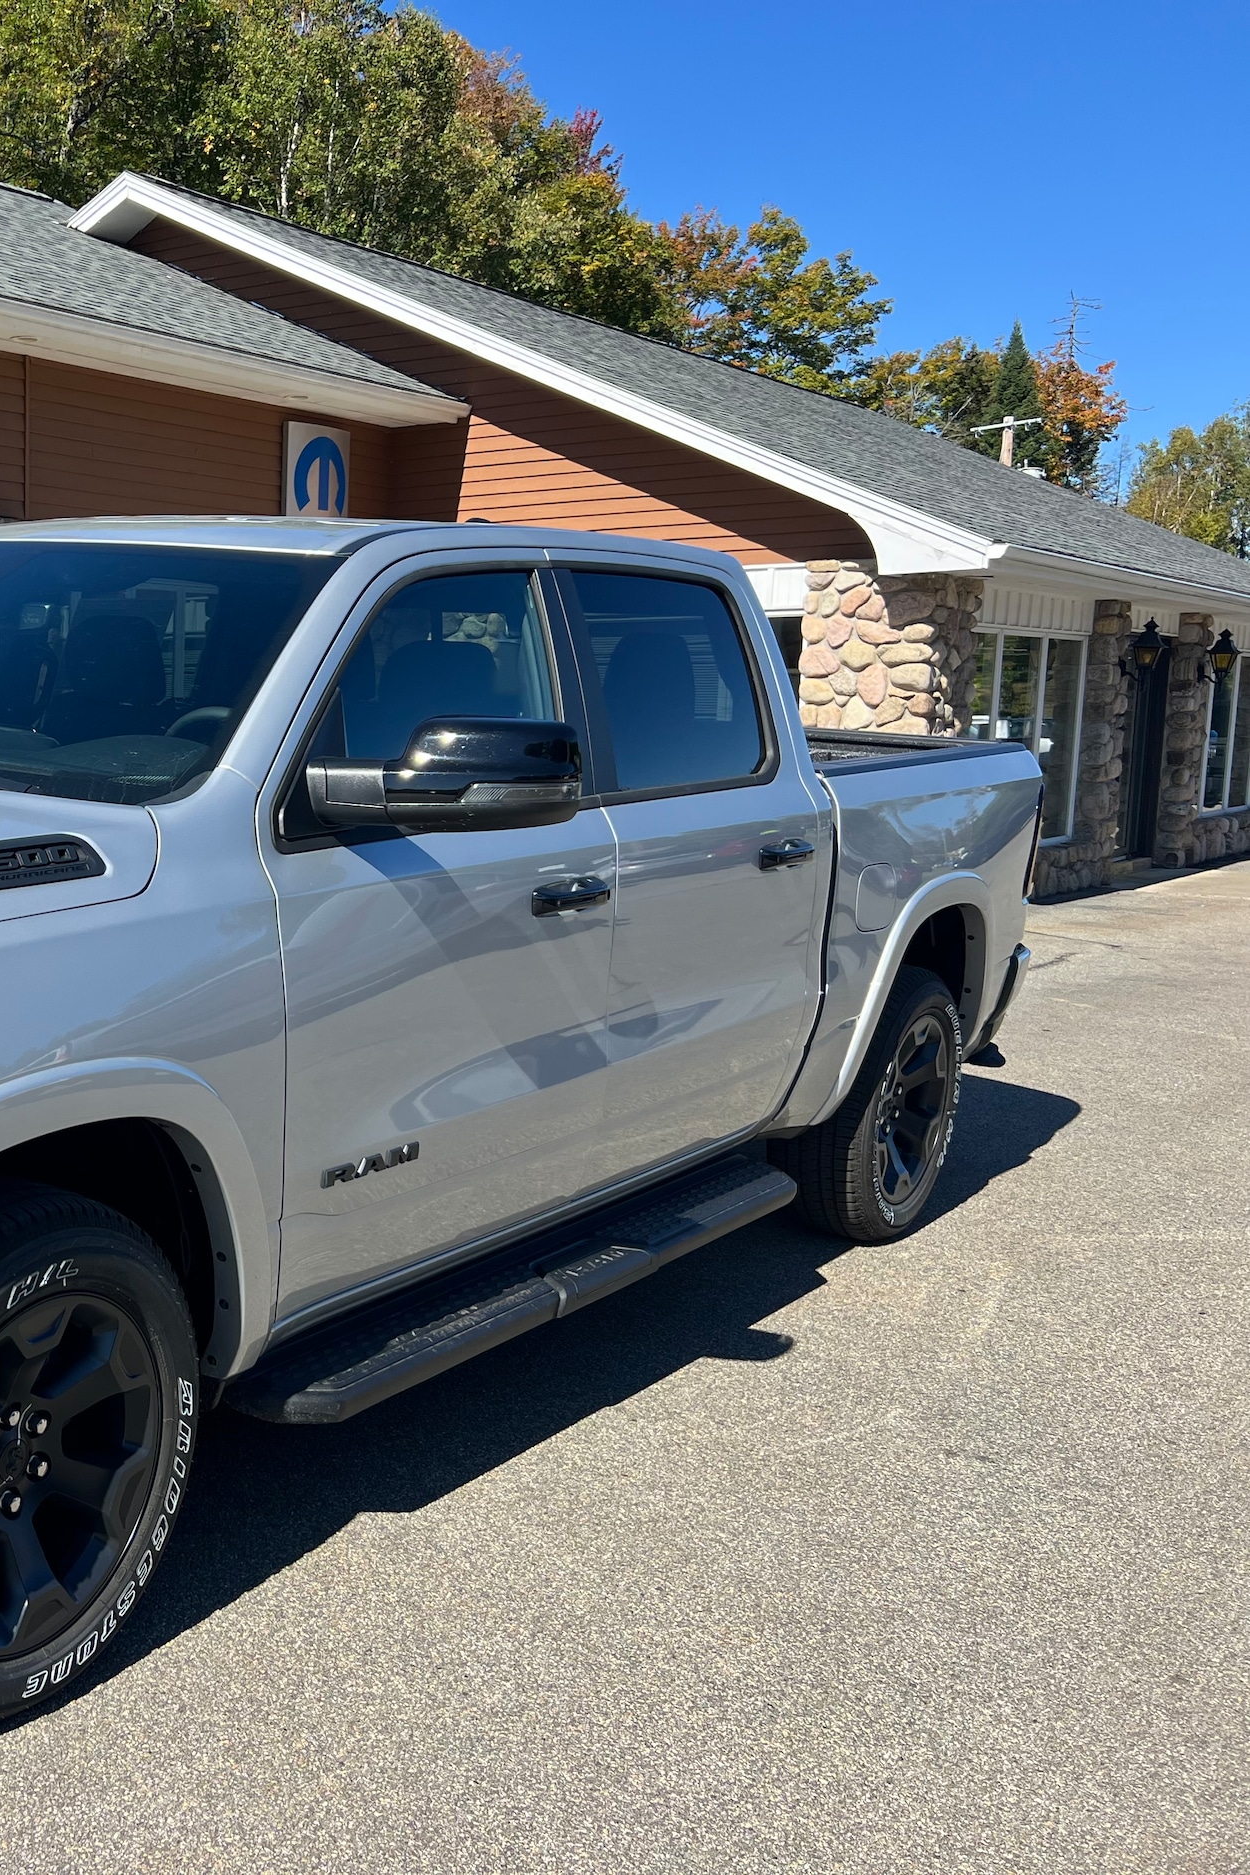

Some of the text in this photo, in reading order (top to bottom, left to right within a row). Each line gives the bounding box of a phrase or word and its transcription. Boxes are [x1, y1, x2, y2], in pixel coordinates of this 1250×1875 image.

[320, 1141, 420, 1189] RAM
[6, 1258, 80, 1310] H/L
[22, 1376, 195, 1700] BRIDGESTONE
